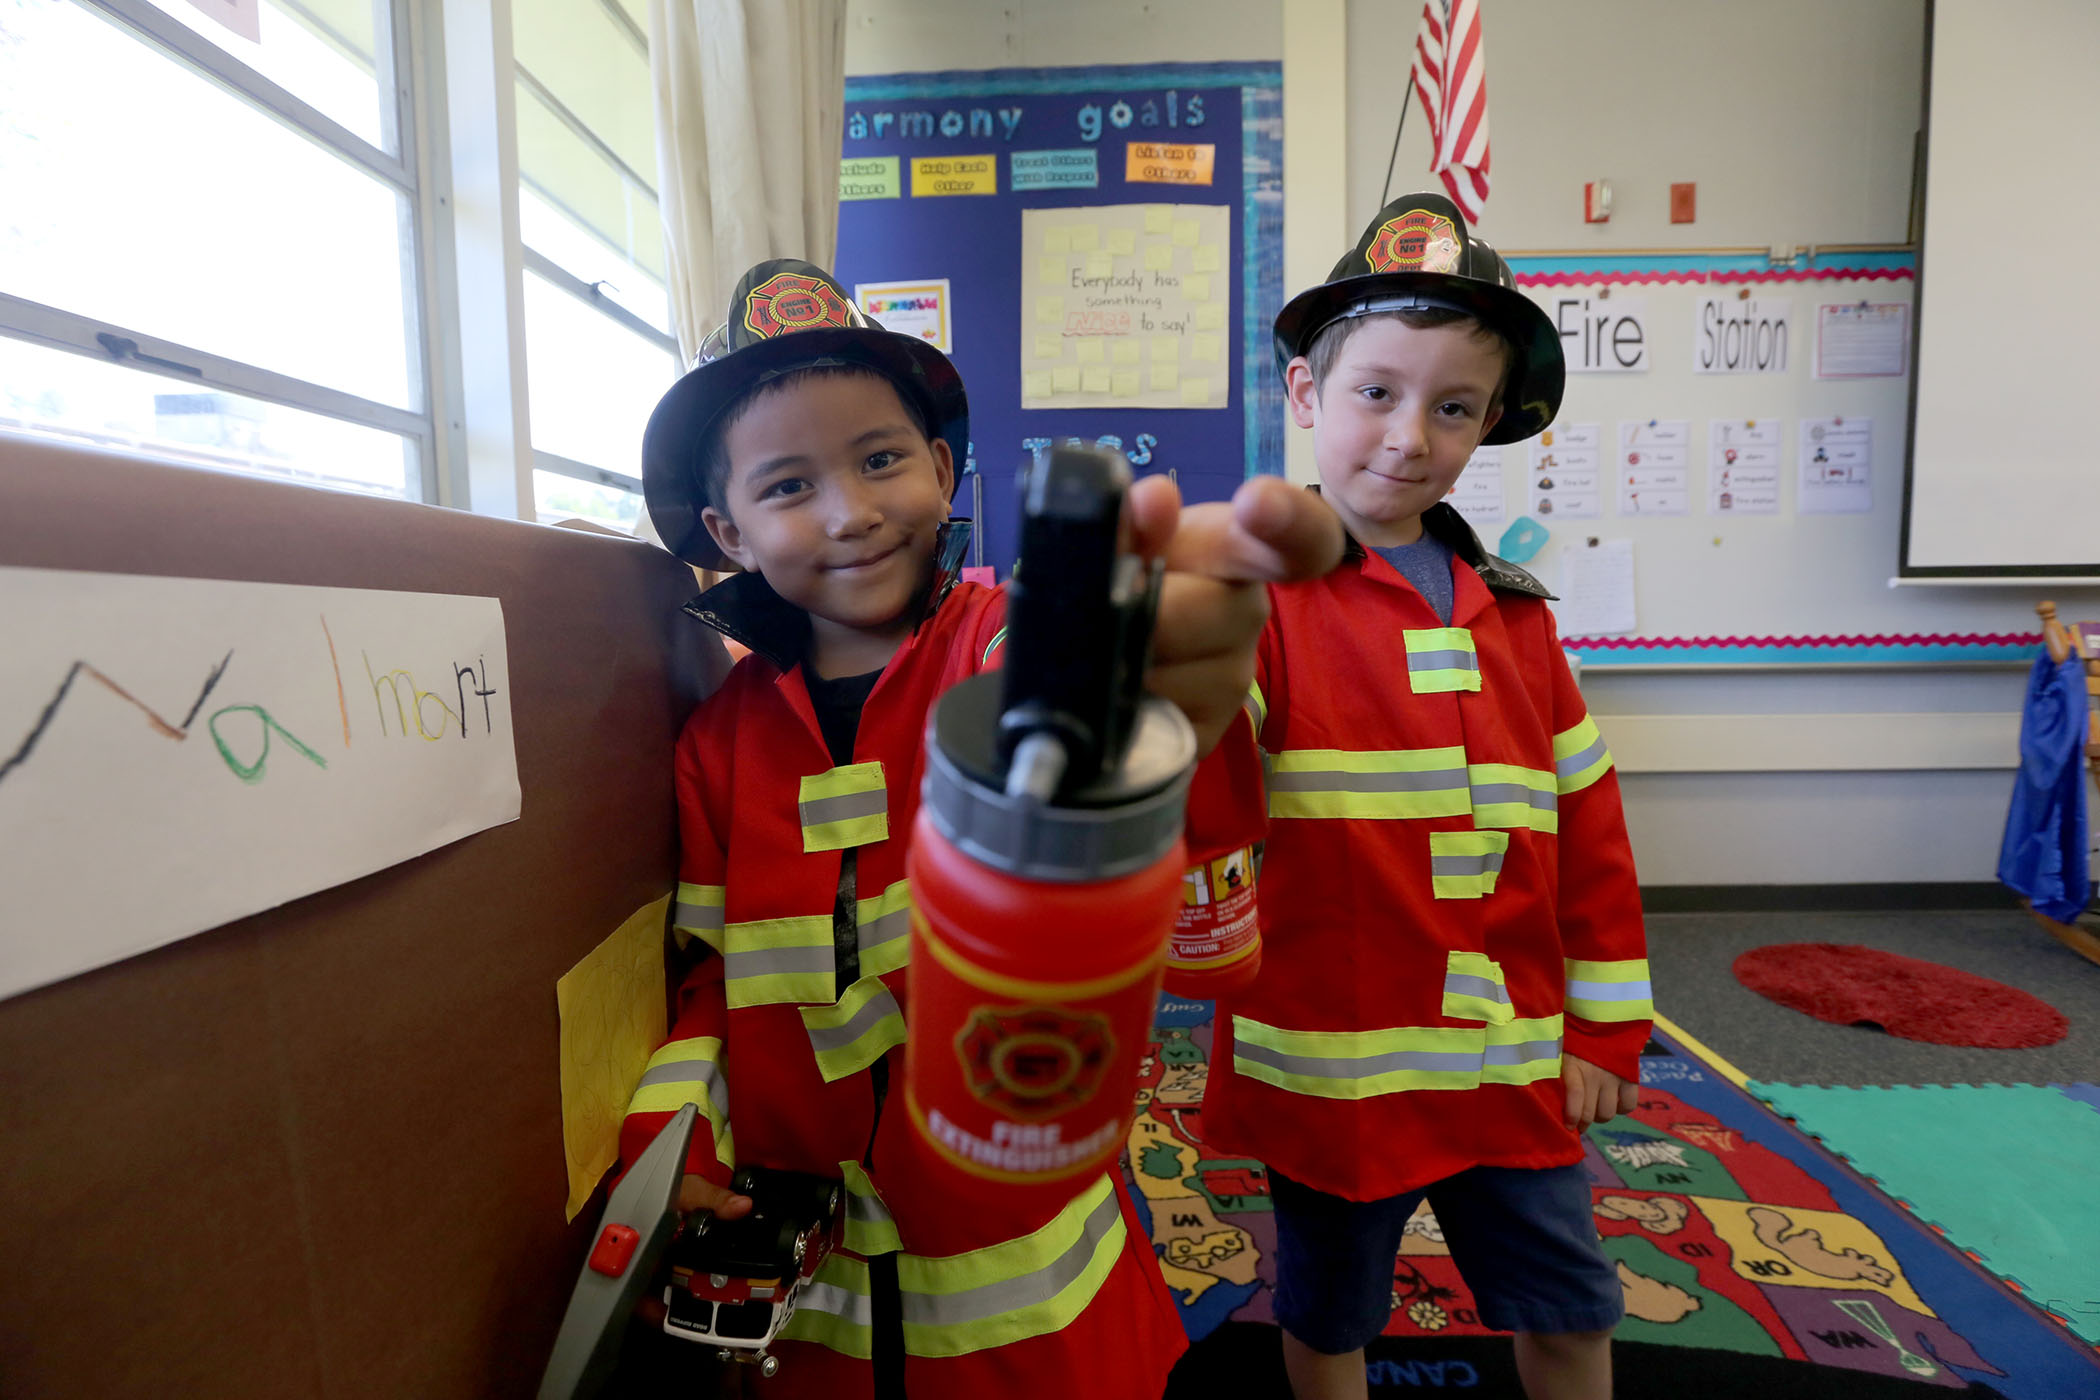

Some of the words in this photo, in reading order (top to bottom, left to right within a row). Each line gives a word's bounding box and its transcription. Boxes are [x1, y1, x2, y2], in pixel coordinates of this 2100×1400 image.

[849, 109, 1022, 140] armony
[1077, 89, 1206, 142] goals
[1135, 146, 1184, 160] Listen
[919, 163, 952, 175] Help
[954, 161, 988, 173] Each
[1014, 157, 1048, 168] Treat
[1050, 155, 1093, 167] Others
[840, 162, 886, 176] nclude
[1142, 166, 1196, 180] Others
[1045, 172, 1095, 184] Respect
[933, 180, 974, 193] Other
[1405, 218, 1427, 226] FIRE
[776, 280, 799, 289] FIRE
[1071, 267, 1143, 294] Everybody
[1154, 269, 1180, 287] has
[781, 299, 811, 309] ENGINE
[1085, 295, 1163, 310] something
[1141, 311, 1155, 331] to
[1558, 300, 1643, 368] Fire
[1702, 301, 1788, 369] Station
[1181, 944, 1219, 955] CAUTION:
[1161, 1002, 1206, 1013] Gulf
[1168, 1051, 1196, 1059] LA
[1170, 1063, 1197, 1072] AR
[1639, 1061, 1690, 1073] Ocea
[1639, 1070, 1704, 1083] Pacif
[991, 1120, 1063, 1147] FIRE
[1138, 1122, 1159, 1134] IL
[927, 1107, 1120, 1173] EXTINGUISHER
[1213, 1194, 1245, 1208] IA
[1171, 1213, 1205, 1228] WI
[1679, 1242, 1714, 1258] ID
[1742, 1259, 1793, 1277] OR
[1807, 1329, 1879, 1349] WA
[1365, 1358, 1480, 1388] CANA
